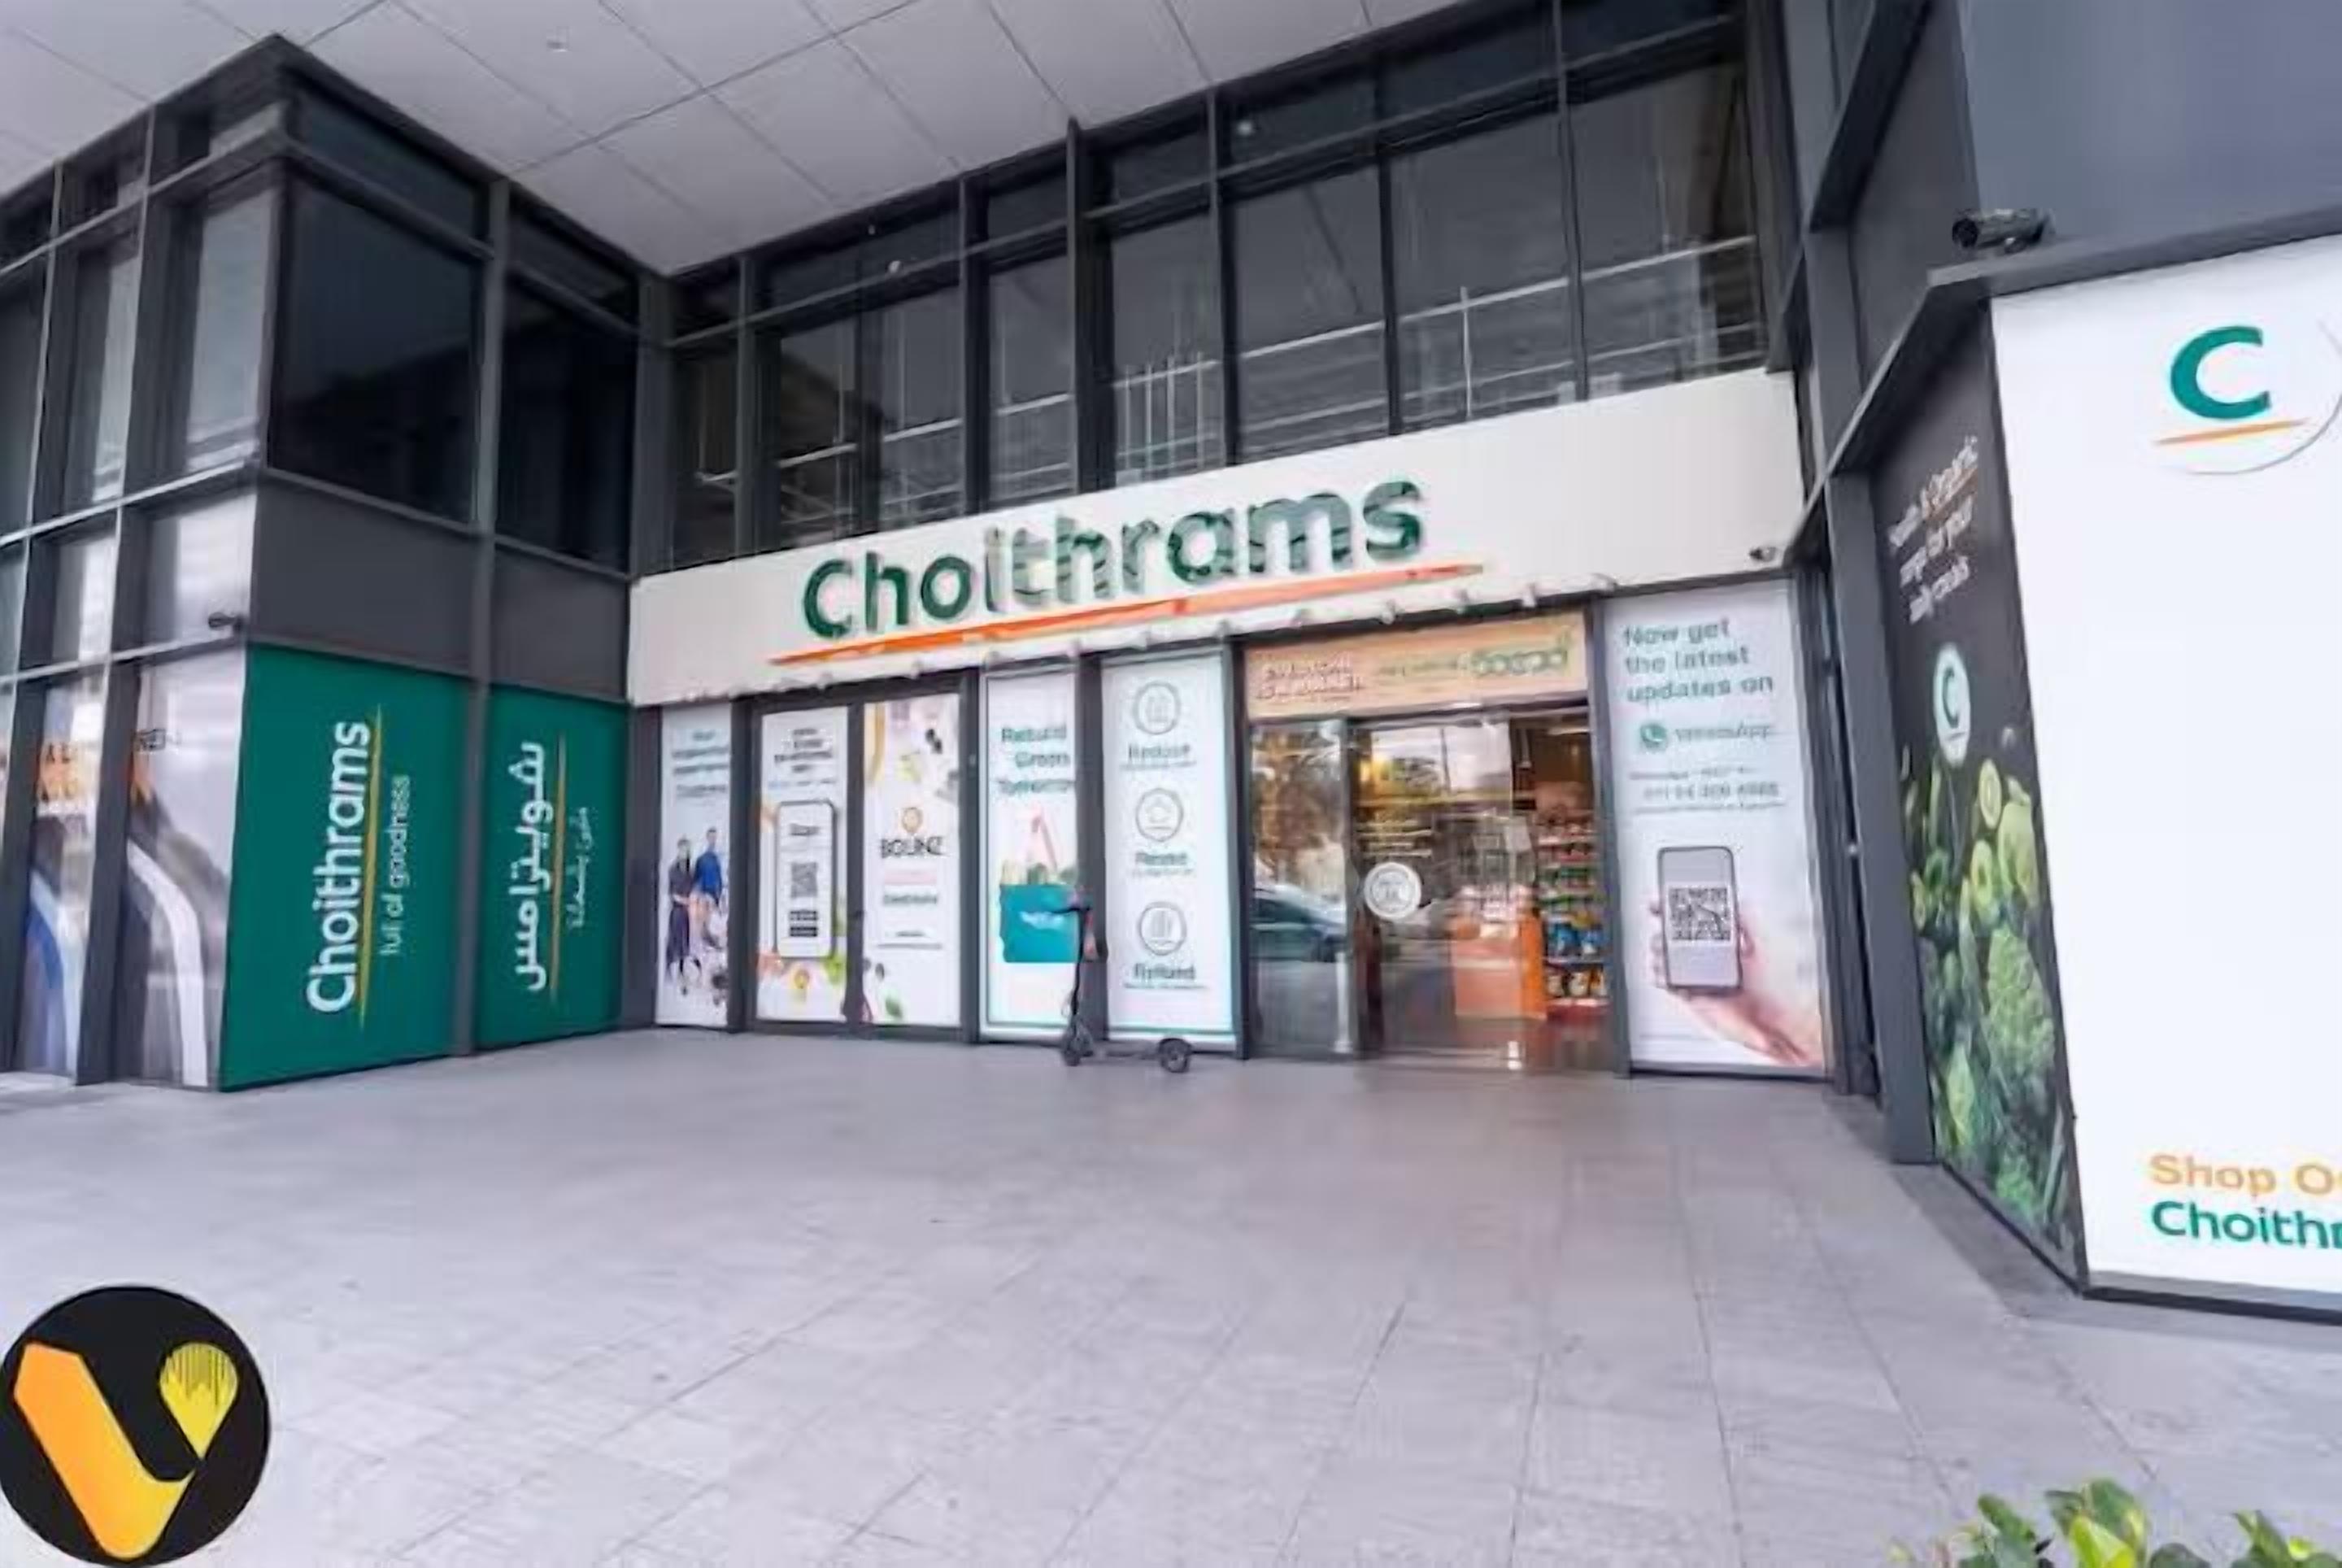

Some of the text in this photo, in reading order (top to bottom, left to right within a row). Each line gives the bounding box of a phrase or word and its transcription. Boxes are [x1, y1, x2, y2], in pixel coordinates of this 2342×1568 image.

[2170, 324, 2272, 421] C
[801, 478, 1425, 641] Choithrams
[306, 721, 371, 1013] Choithrams
[2149, 1153, 2342, 1200] Shop O
